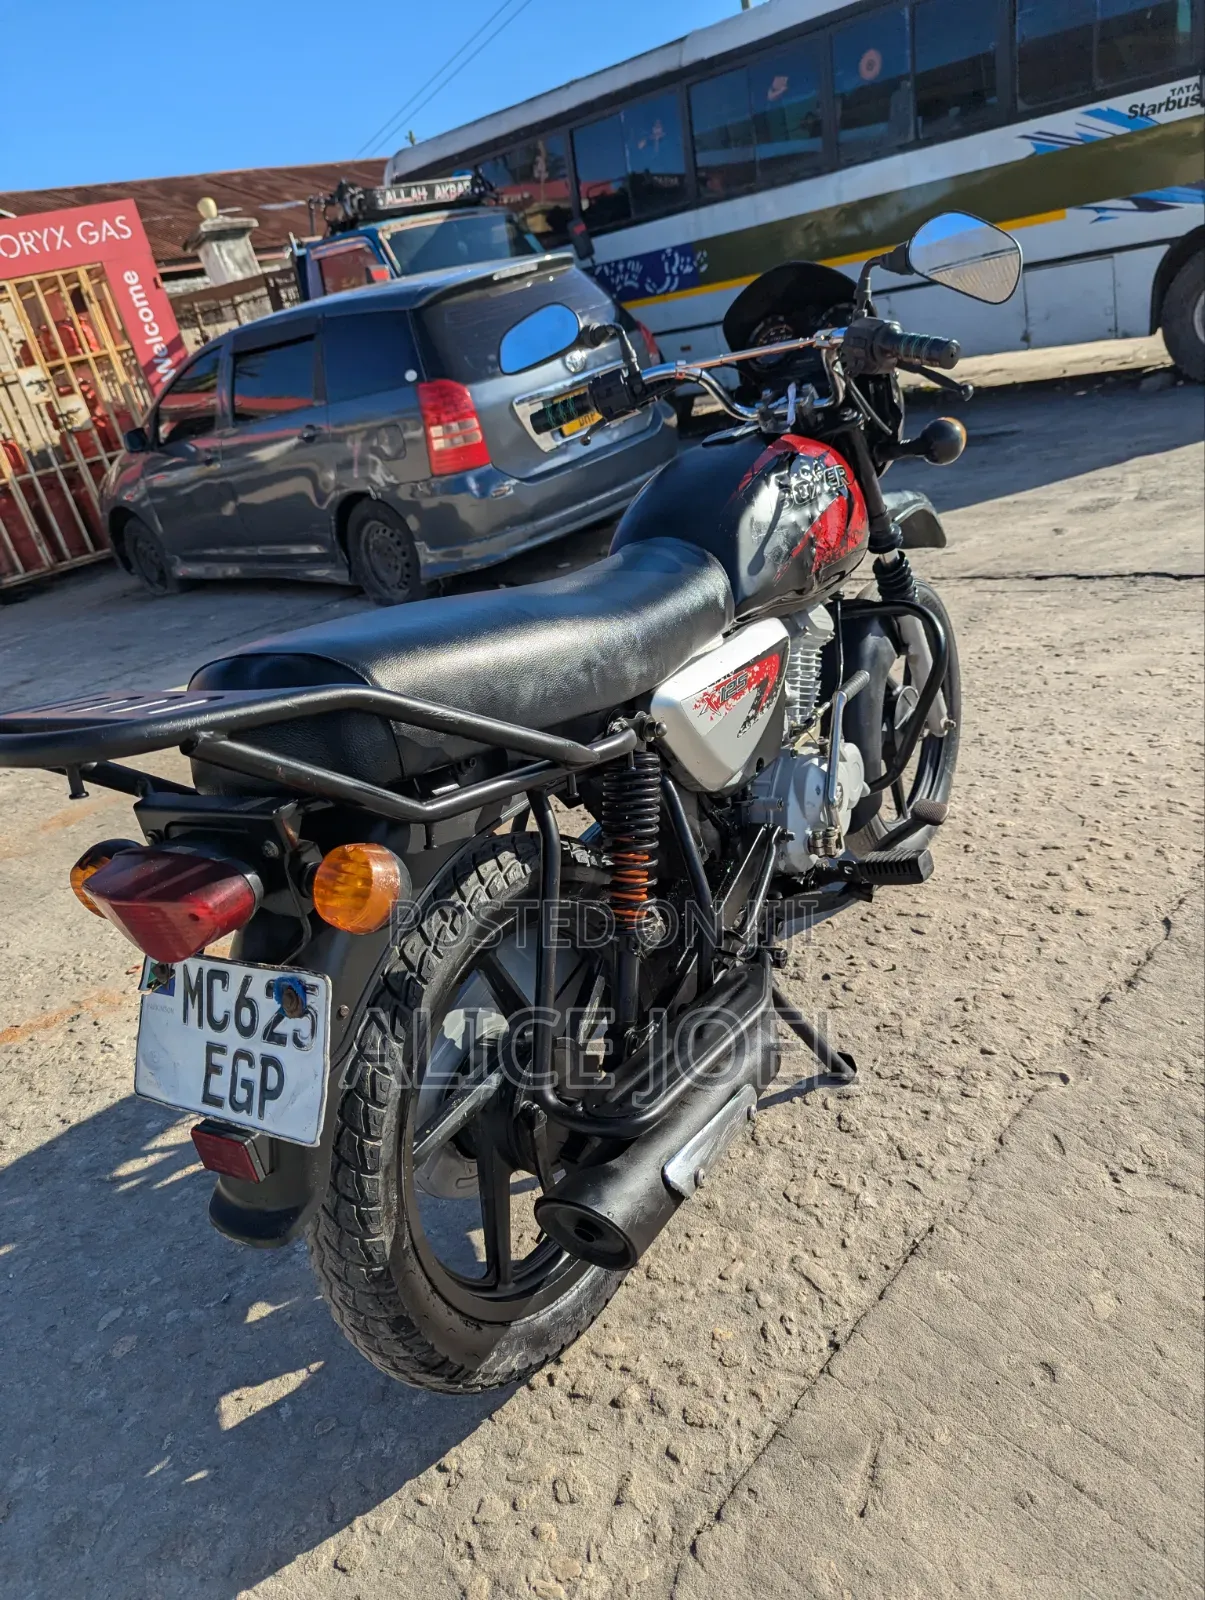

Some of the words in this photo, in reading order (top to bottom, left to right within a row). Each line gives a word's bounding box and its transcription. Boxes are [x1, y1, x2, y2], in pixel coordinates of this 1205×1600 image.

[1127, 93, 1201, 119] Starbus
[1170, 82, 1201, 96] TATA
[386, 186, 428, 206] ALLAH
[0, 225, 72, 258] ORYX
[77, 215, 132, 245] GAS
[123, 269, 177, 382] Welcome
[201, 1040, 285, 1120] EGP
